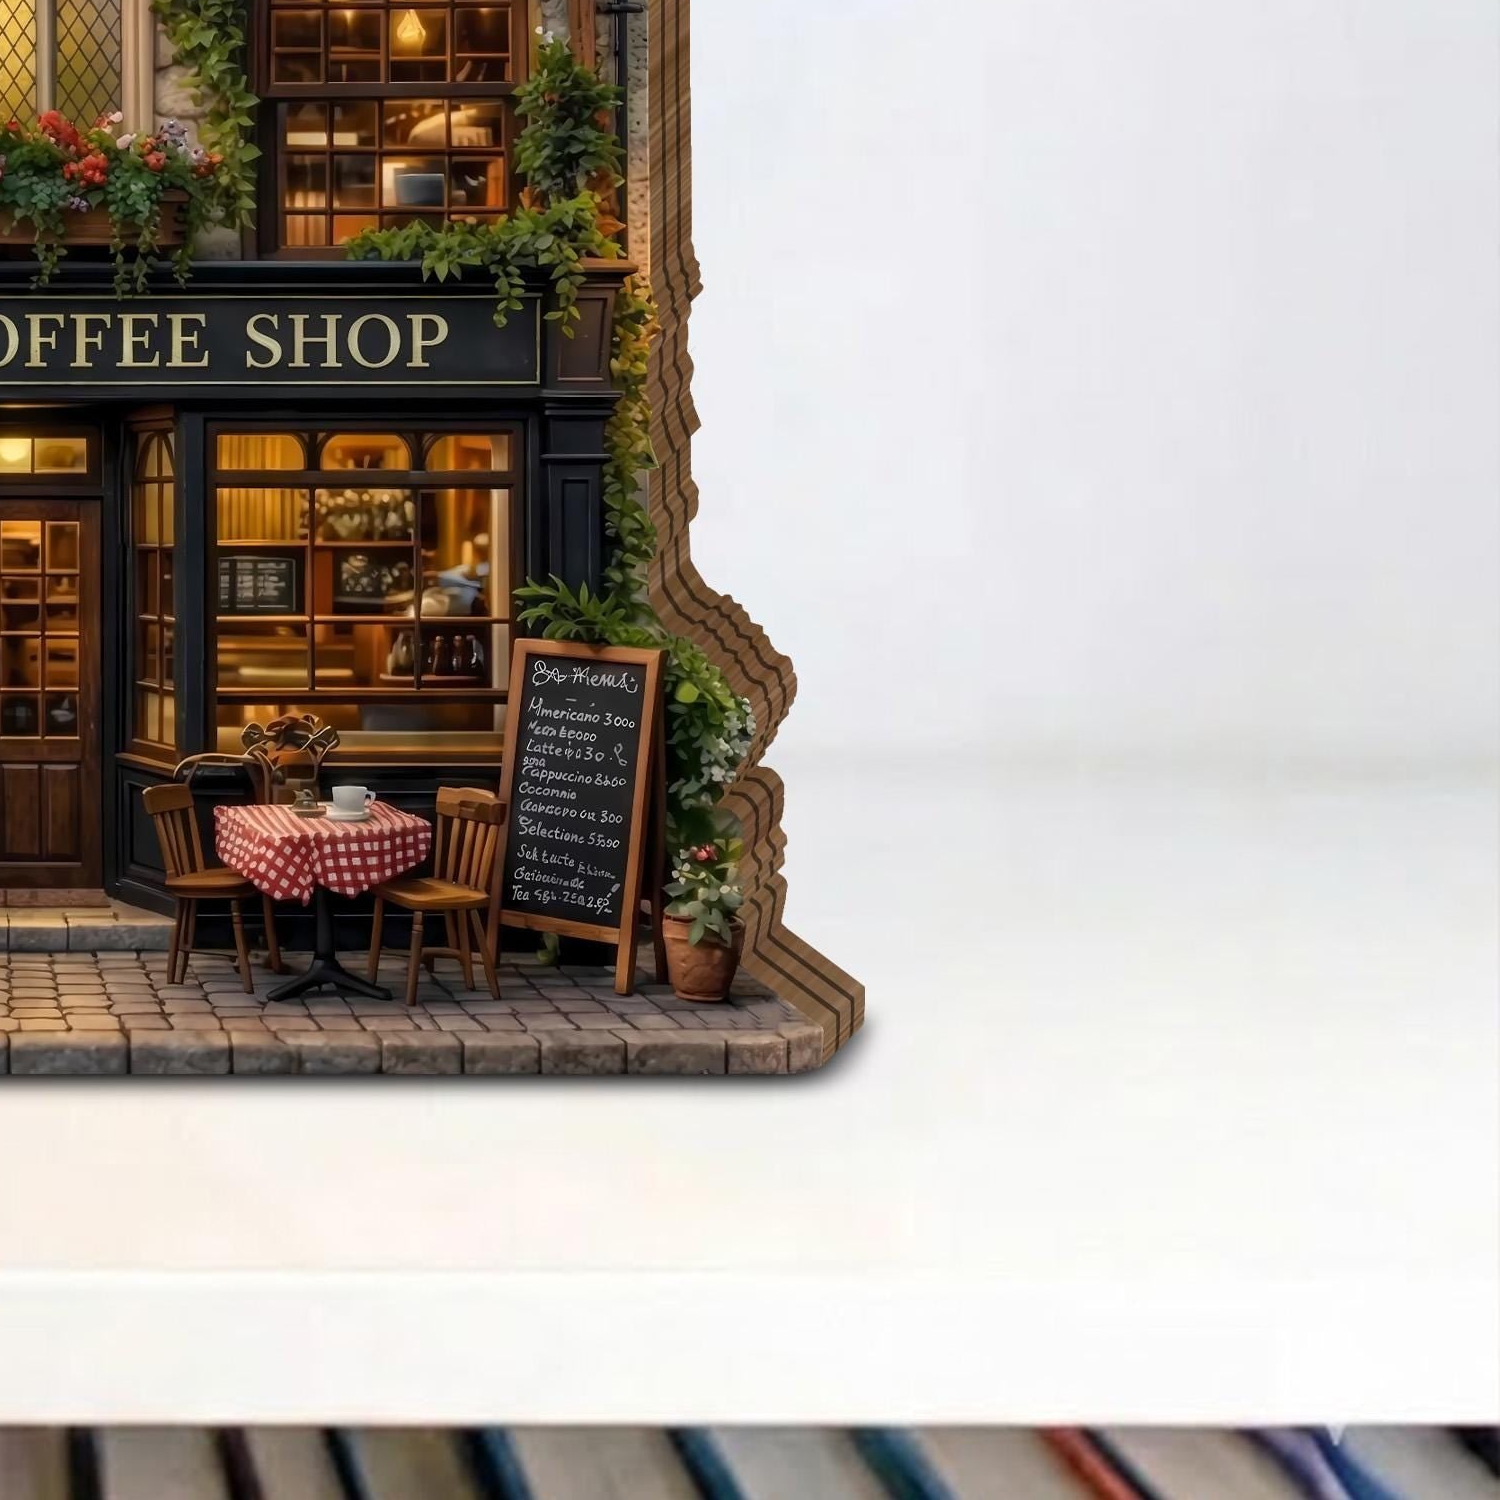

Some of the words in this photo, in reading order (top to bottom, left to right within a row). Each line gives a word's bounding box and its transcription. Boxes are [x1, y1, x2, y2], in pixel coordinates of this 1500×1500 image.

[246, 312, 449, 368] SHOP
[526, 739, 562, 756] Latte
[522, 765, 592, 784] Cappuccino
[512, 885, 530, 901] Tea
